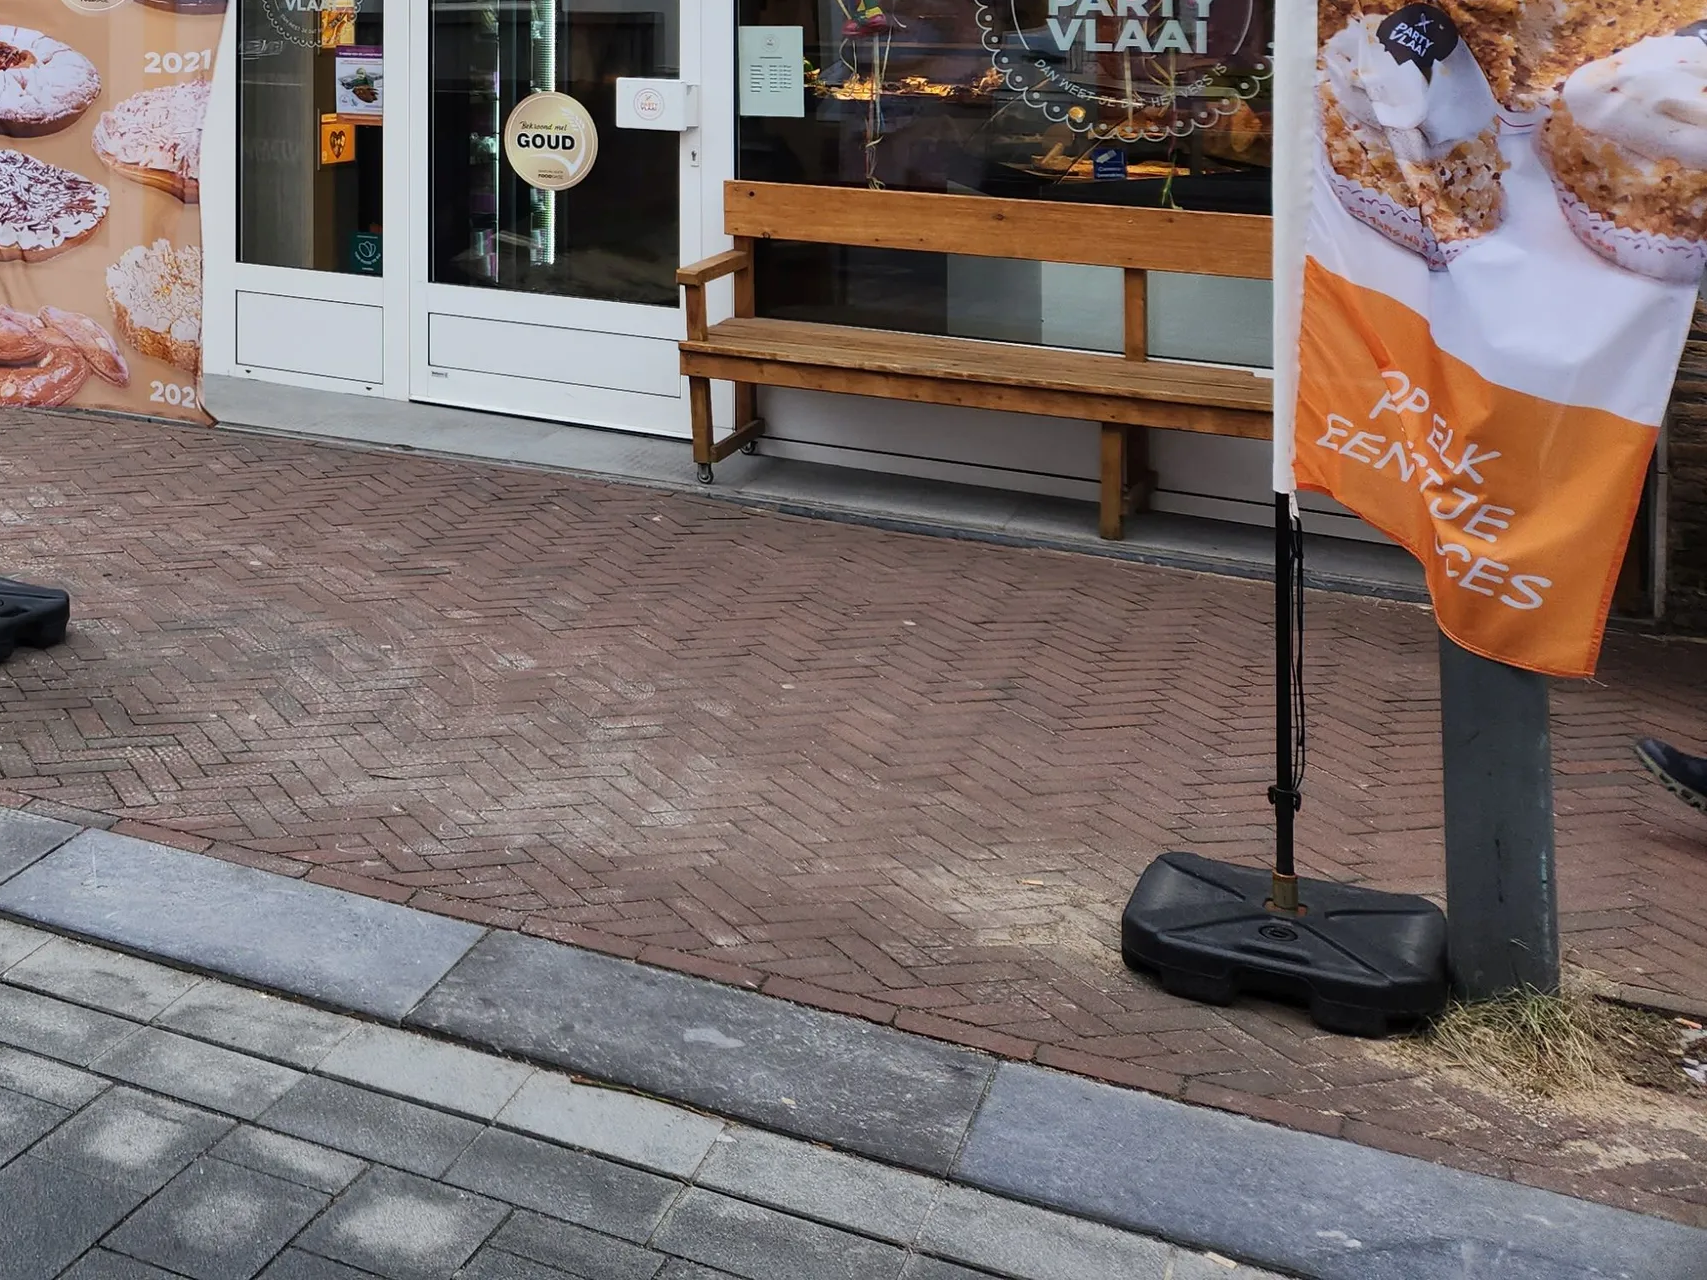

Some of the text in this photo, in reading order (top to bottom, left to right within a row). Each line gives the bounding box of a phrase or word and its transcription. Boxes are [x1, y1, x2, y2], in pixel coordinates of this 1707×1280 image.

[1046, 18, 1208, 54] VLAAI
[1389, 30, 1427, 57] VLAAI
[1395, 22, 1434, 49] PARTY
[144, 48, 211, 73] 2021
[1034, 58, 1060, 82] DAN
[1059, 77, 1096, 102] WEET
[1098, 98, 1116, 108] JE
[1151, 93, 1176, 108] HET
[1180, 74, 1214, 98] VERS
[1214, 62, 1228, 77] IS
[517, 133, 575, 150] GOUD
[150, 380, 195, 409] 202
